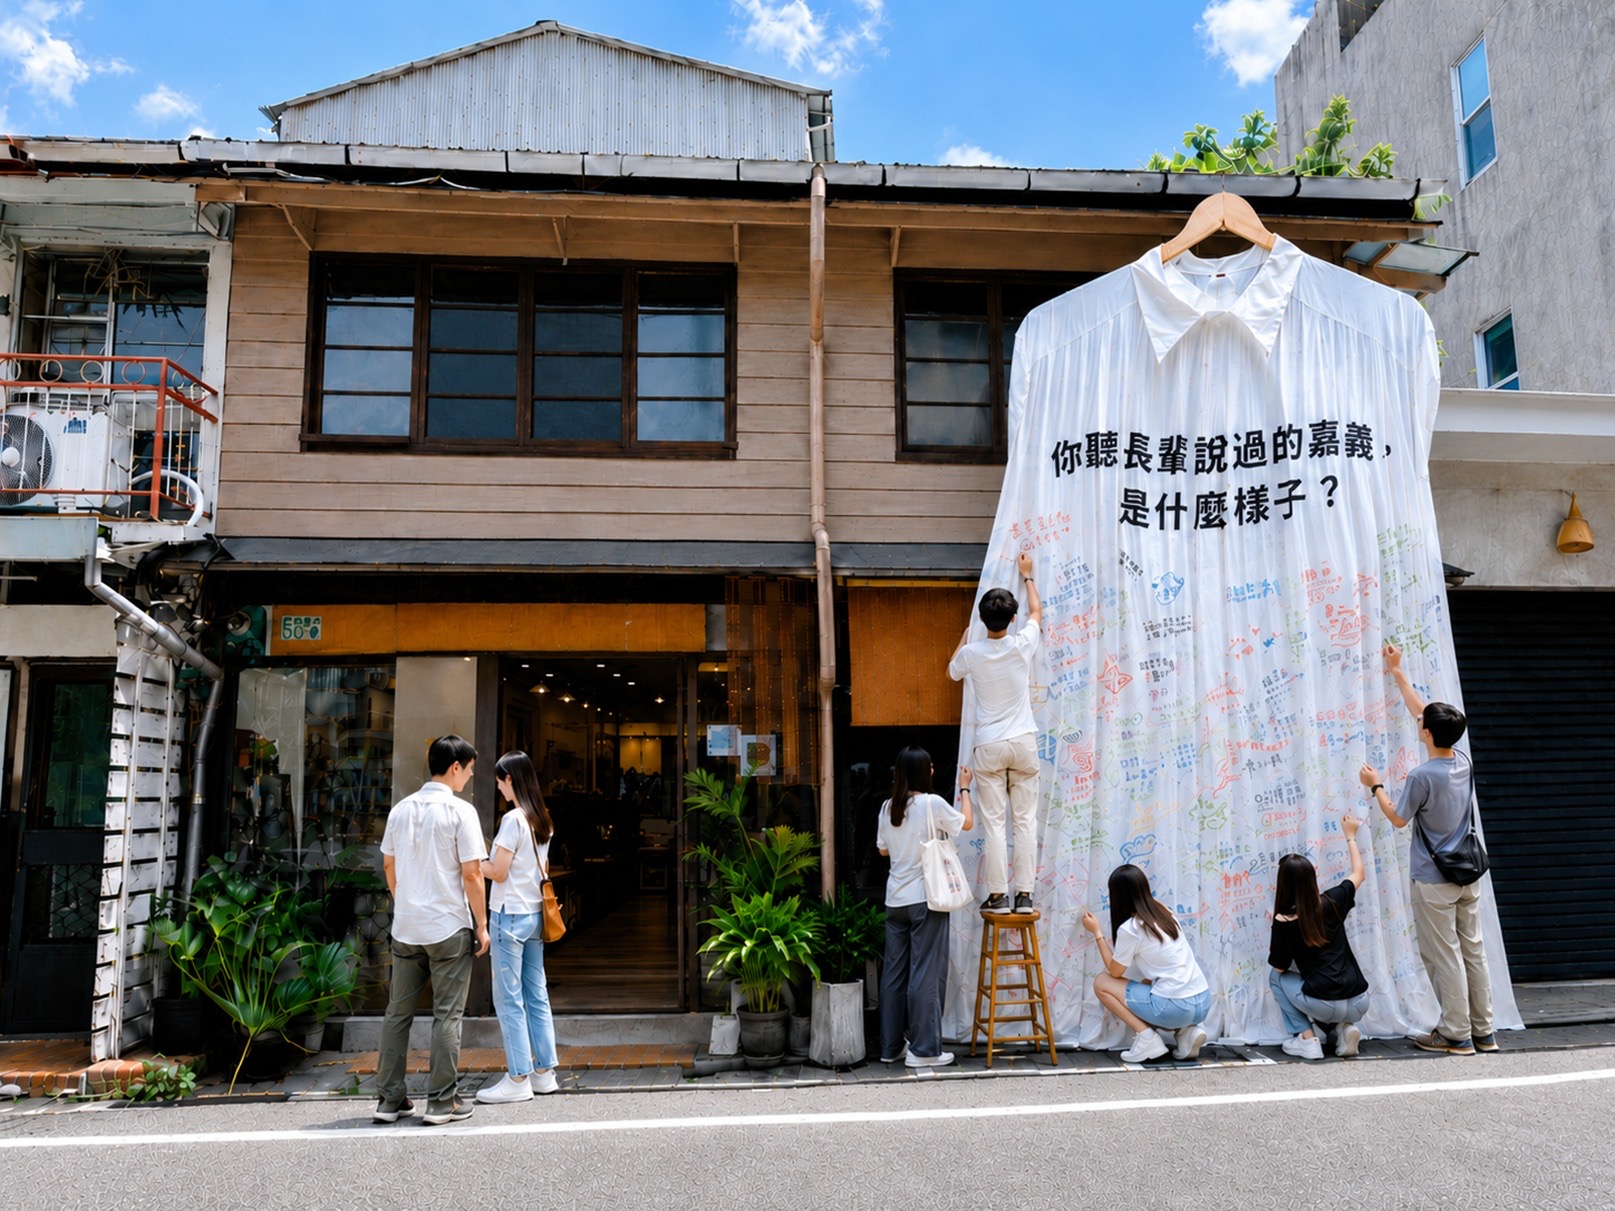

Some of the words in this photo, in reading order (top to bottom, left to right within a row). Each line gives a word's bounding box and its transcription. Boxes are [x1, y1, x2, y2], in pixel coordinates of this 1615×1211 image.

[1050, 419, 1392, 478] 你聽長輩說過的嘉義，
[1118, 474, 1339, 531] 是什麼樣子？
